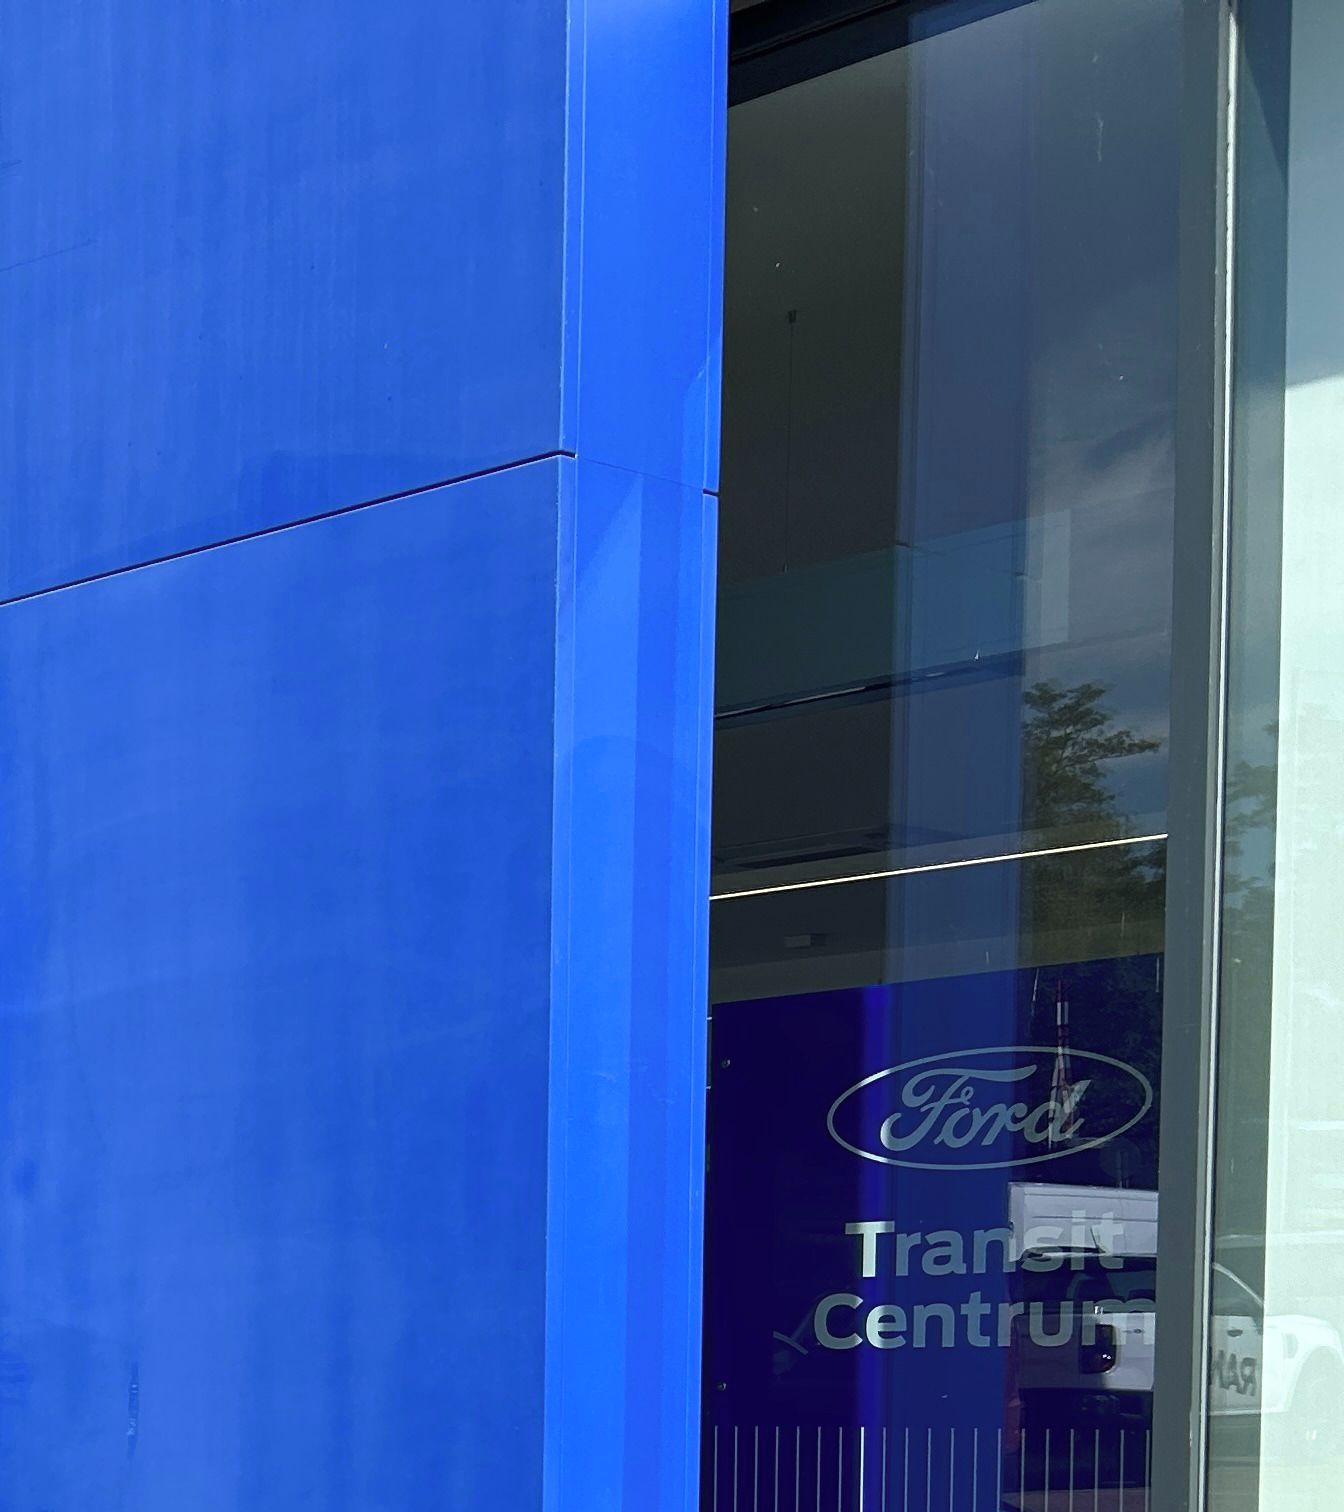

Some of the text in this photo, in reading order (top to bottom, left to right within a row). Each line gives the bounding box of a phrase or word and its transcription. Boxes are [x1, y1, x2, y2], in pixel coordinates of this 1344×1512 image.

[880, 1065, 1093, 1152] Ford
[845, 1210, 1126, 1278] Transit
[813, 1290, 1157, 1351] Centrum
